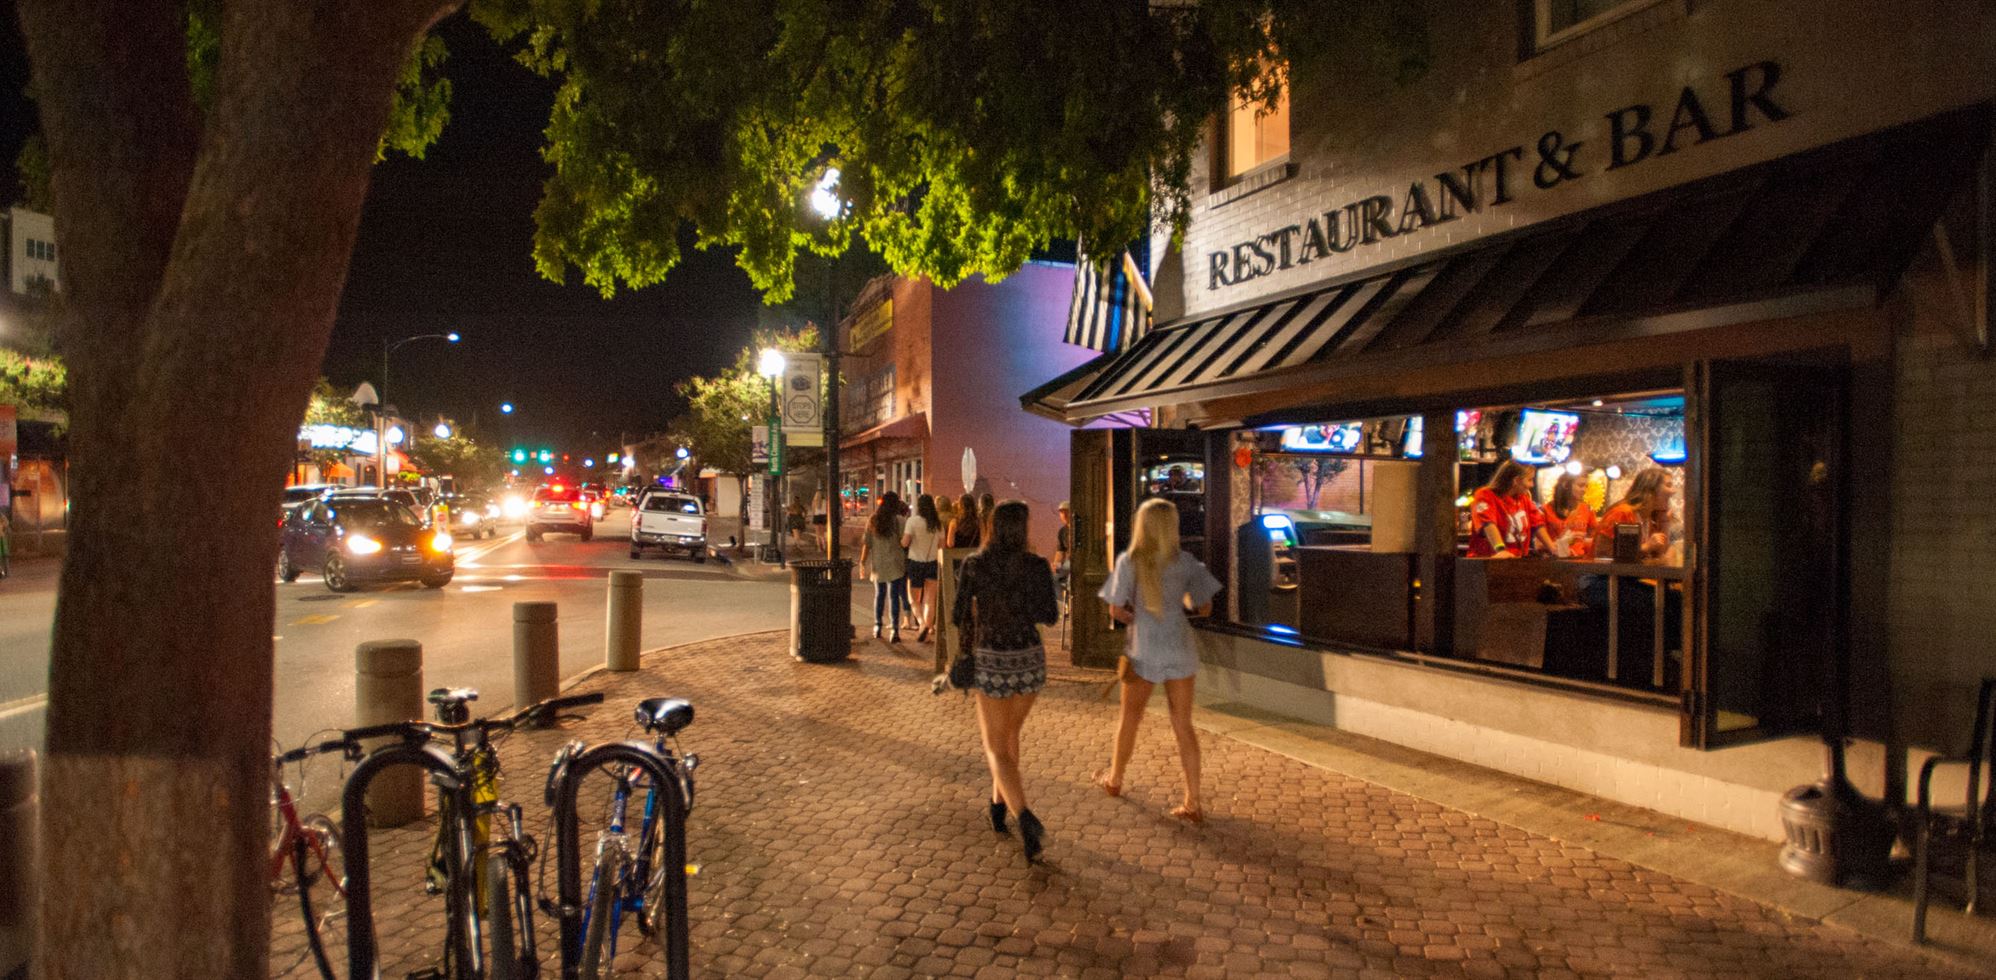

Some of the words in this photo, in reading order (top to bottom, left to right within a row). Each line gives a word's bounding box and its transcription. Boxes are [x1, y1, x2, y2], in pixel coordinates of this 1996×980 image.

[1207, 146, 1521, 291] RESTAURANT
[1533, 131, 1583, 190] &
[1605, 60, 1792, 172] BAR
